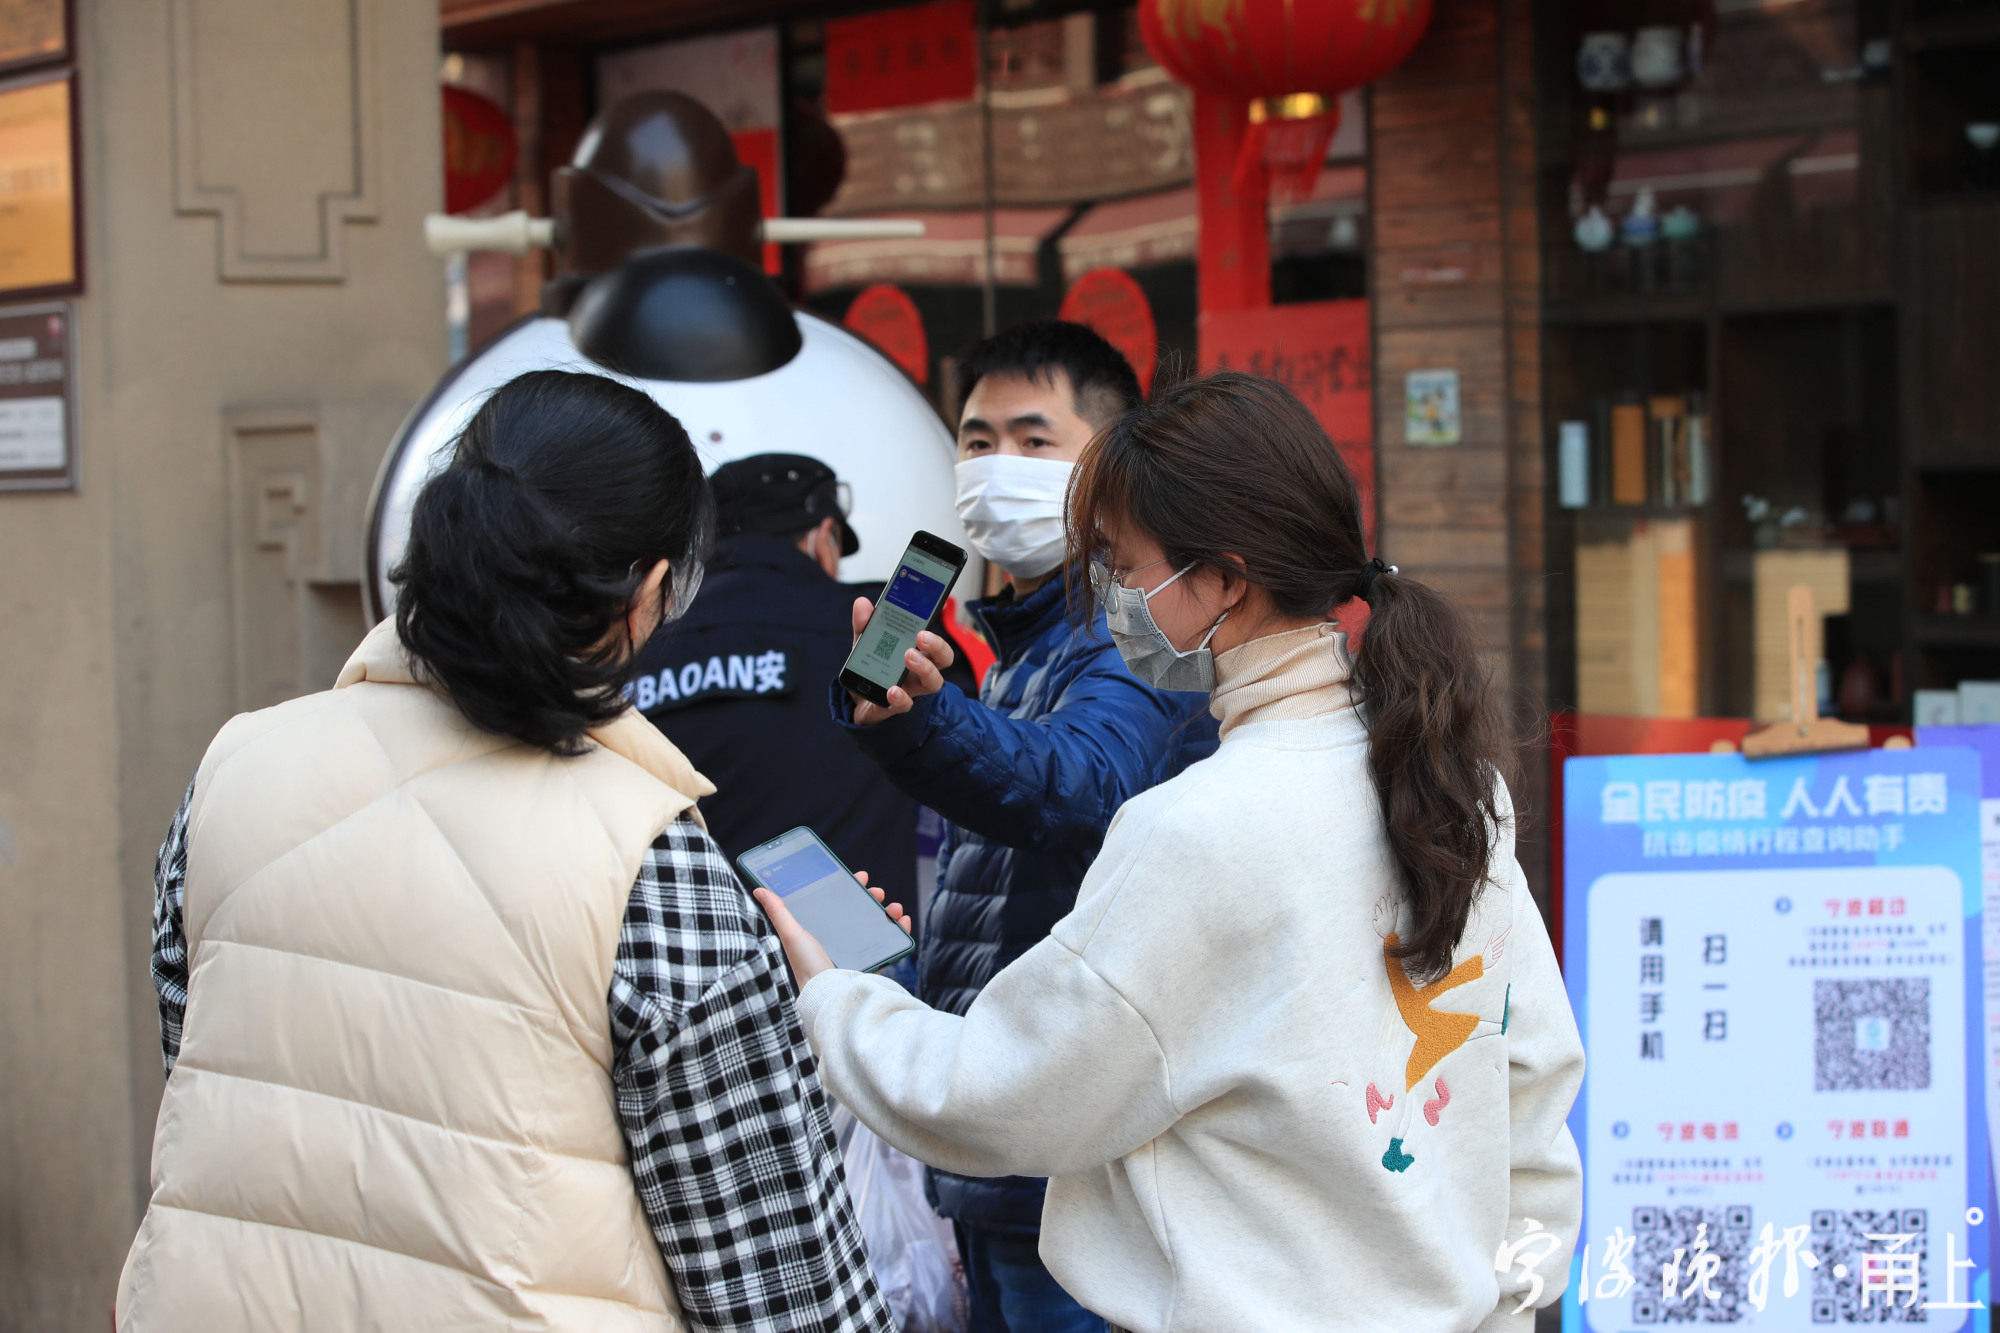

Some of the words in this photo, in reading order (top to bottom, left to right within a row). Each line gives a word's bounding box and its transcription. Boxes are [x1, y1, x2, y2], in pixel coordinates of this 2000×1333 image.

[1601, 779, 1767, 823] 全民防疫
[1780, 772, 1947, 818] 人人有责
[1639, 916, 1664, 1060] 请用手机
[1702, 933, 1728, 1042] 扫一扫
